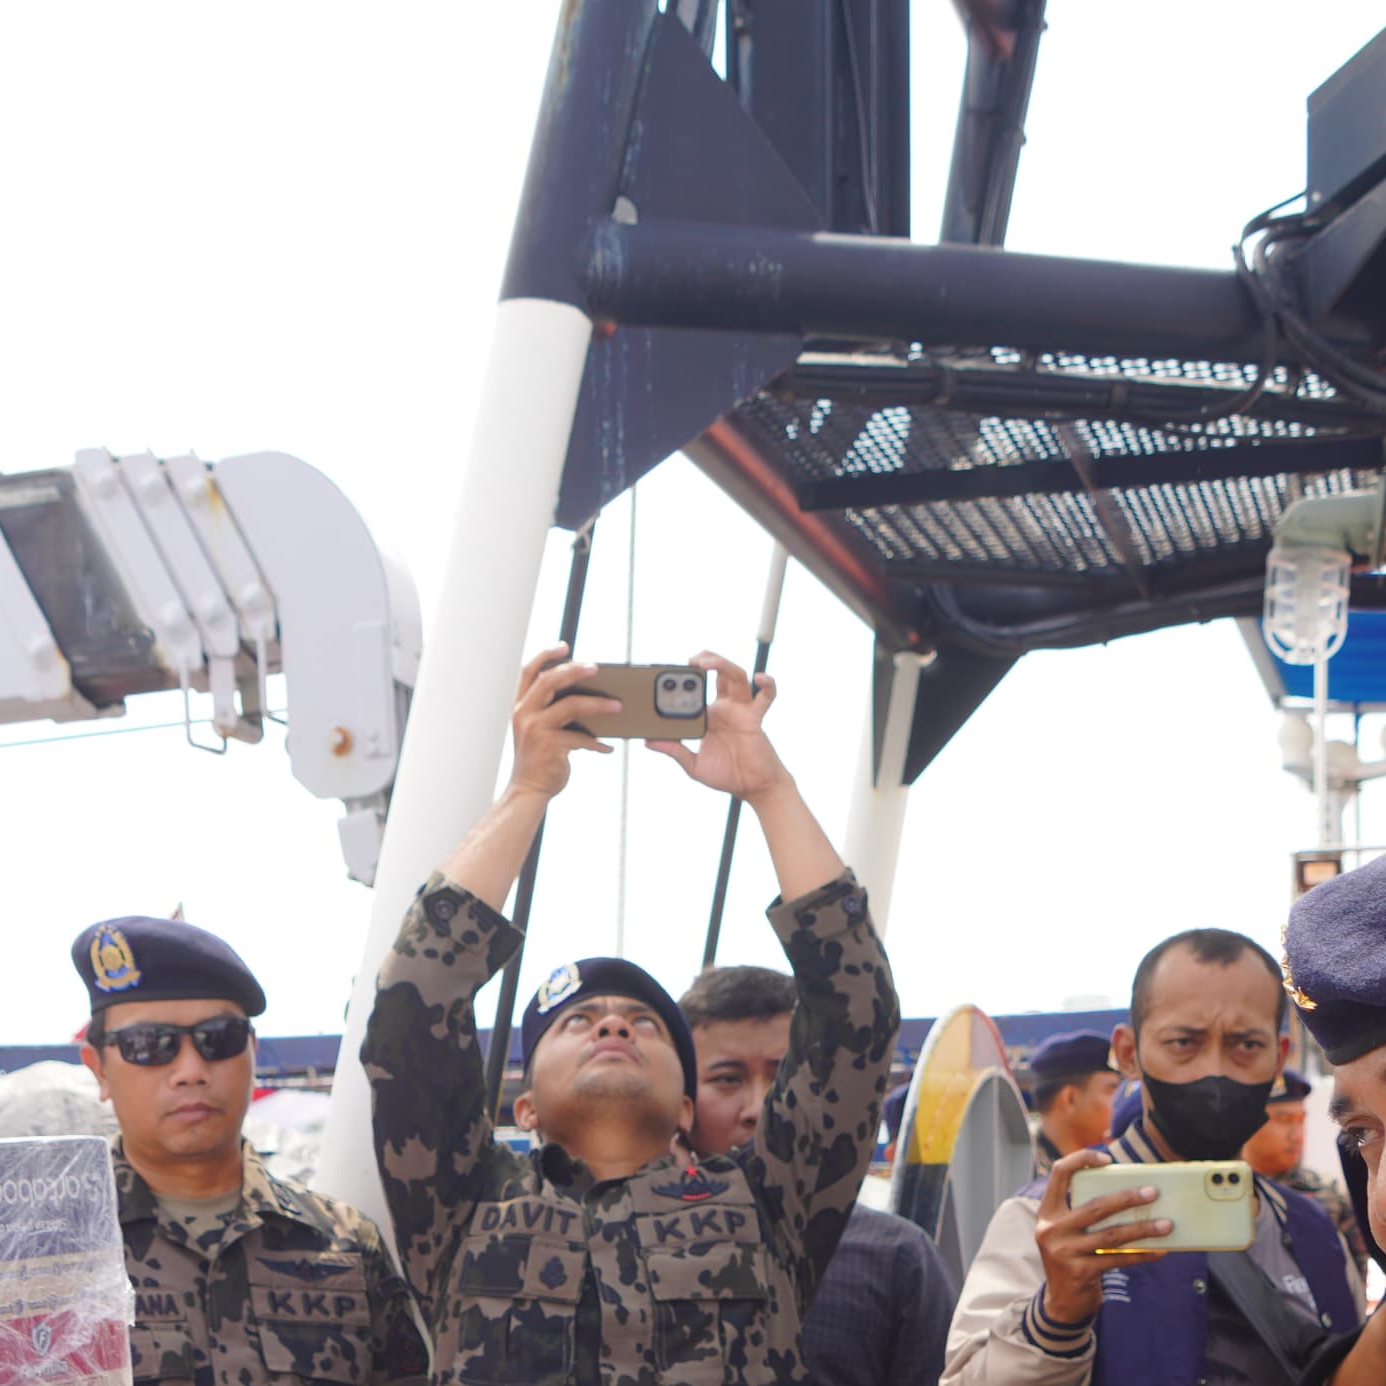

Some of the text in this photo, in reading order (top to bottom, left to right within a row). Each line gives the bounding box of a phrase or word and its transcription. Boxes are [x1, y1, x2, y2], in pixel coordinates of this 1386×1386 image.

[480, 1203, 577, 1235] DAVIT
[654, 1209, 746, 1244] KKP
[268, 1290, 356, 1317] KKP
